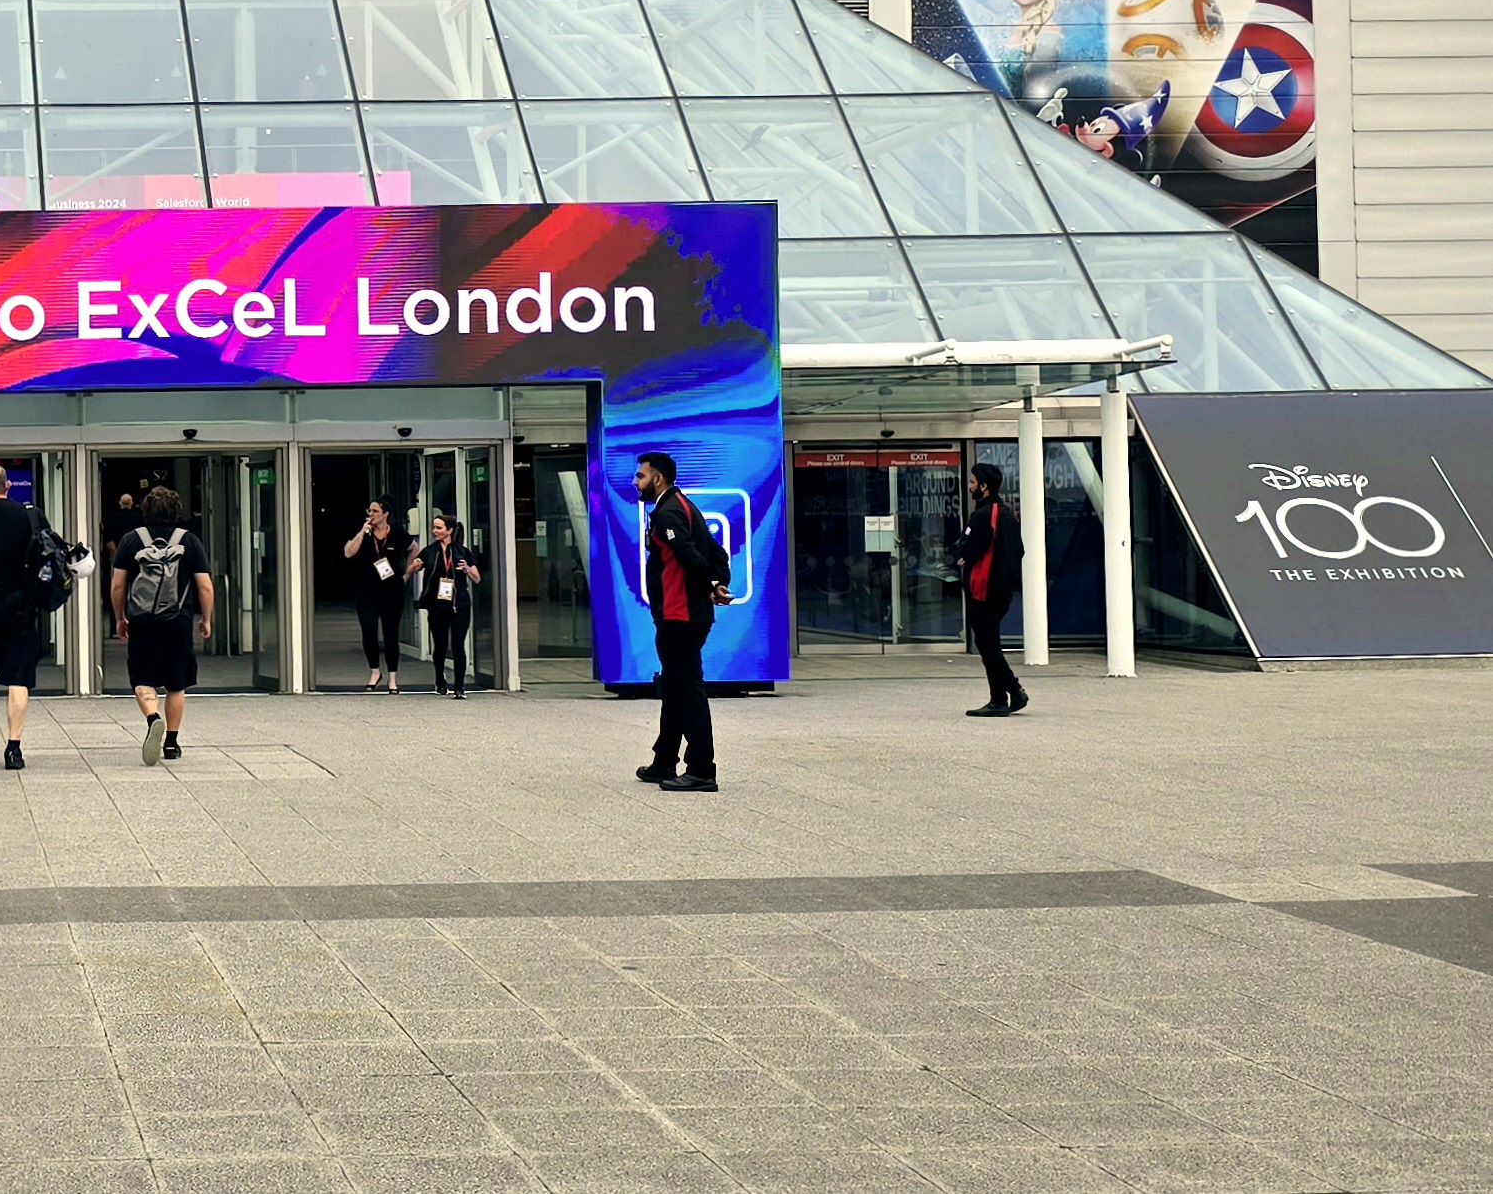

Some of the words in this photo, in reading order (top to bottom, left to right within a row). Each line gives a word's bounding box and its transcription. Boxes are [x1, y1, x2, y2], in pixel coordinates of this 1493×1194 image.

[98, 198, 126, 209] 2024
[214, 197, 250, 207] World
[76, 278, 327, 339] ExCeL
[356, 271, 656, 337] London
[826, 453, 845, 462] EXIT
[910, 452, 928, 461] EXIT
[1248, 462, 1368, 496] Disney
[1235, 495, 1445, 559] 100
[1269, 568, 1316, 581] THE
[1325, 566, 1465, 581] EXHIBITION
